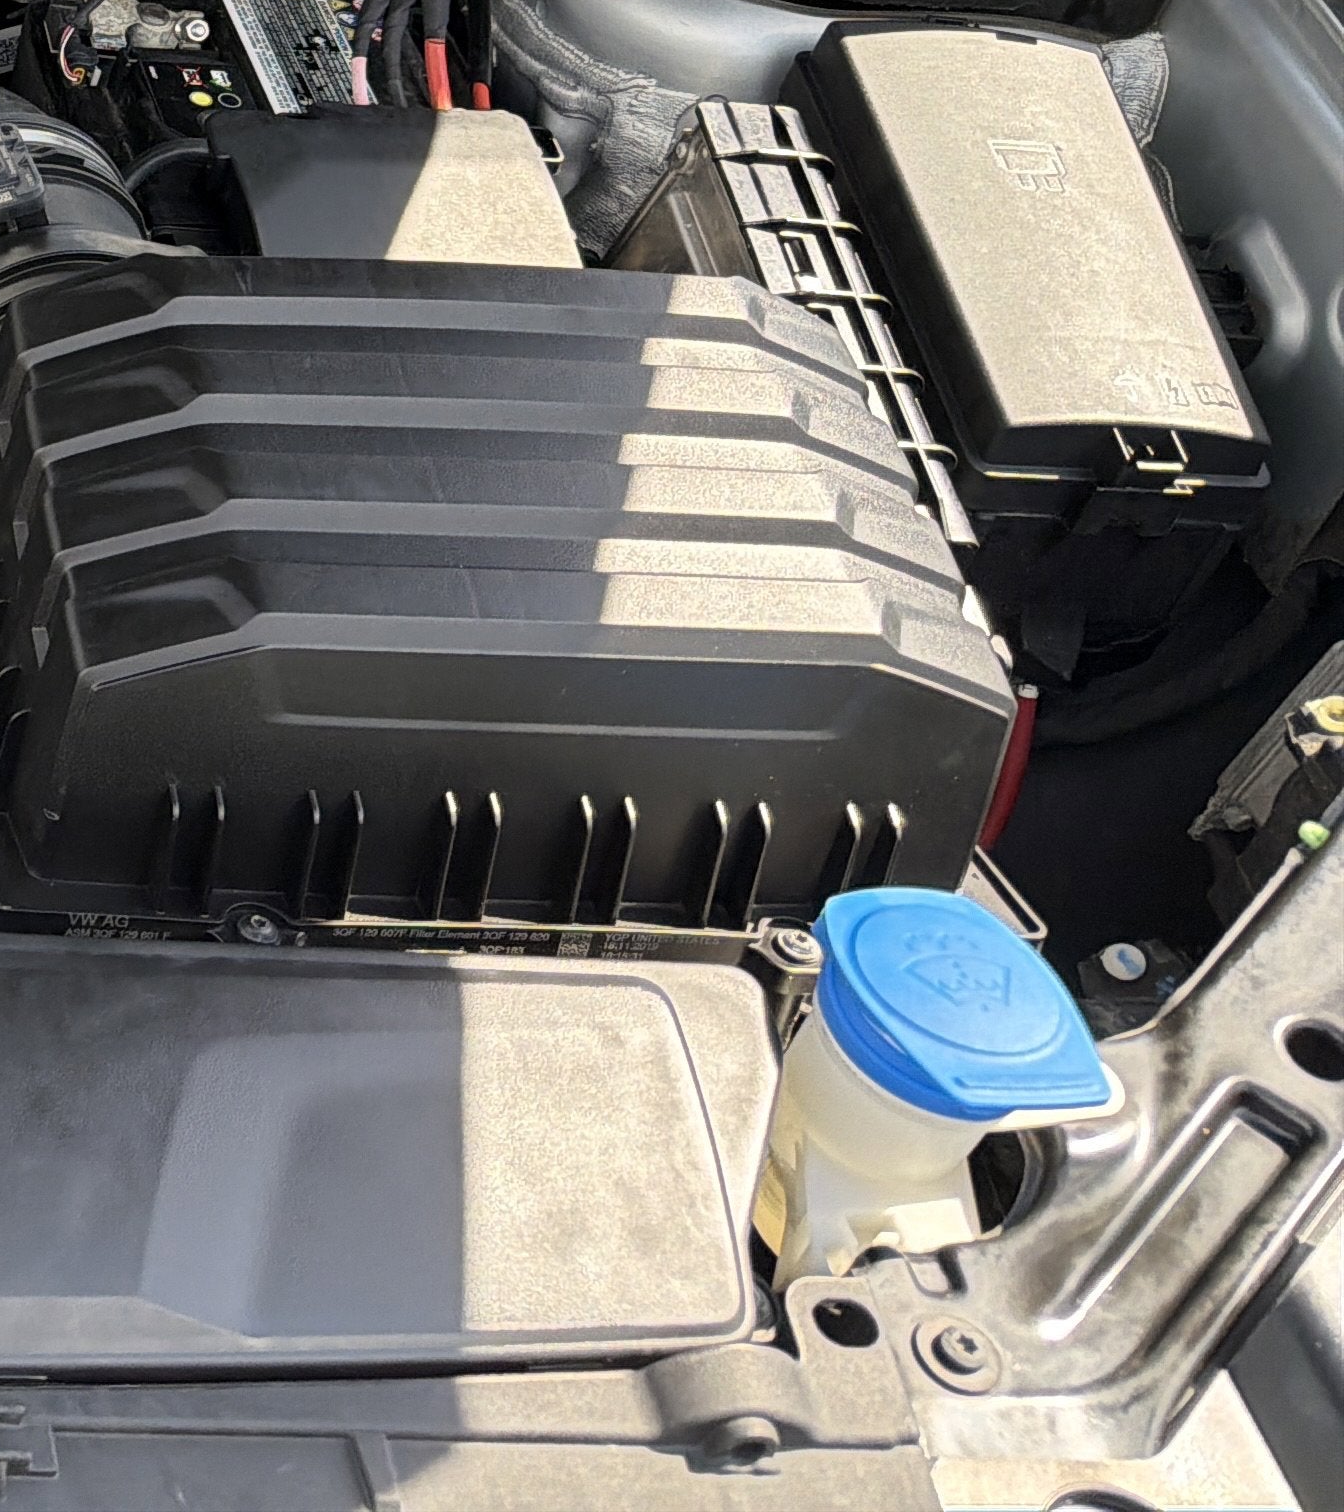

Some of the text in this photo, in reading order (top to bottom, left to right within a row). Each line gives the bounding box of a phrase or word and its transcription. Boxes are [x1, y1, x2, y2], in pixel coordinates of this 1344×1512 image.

[68, 912, 130, 928] VW AG
[64, 928, 91, 938] ASM
[409, 929, 436, 939] Filter
[437, 930, 481, 940] Element
[677, 936, 720, 946] STATES
